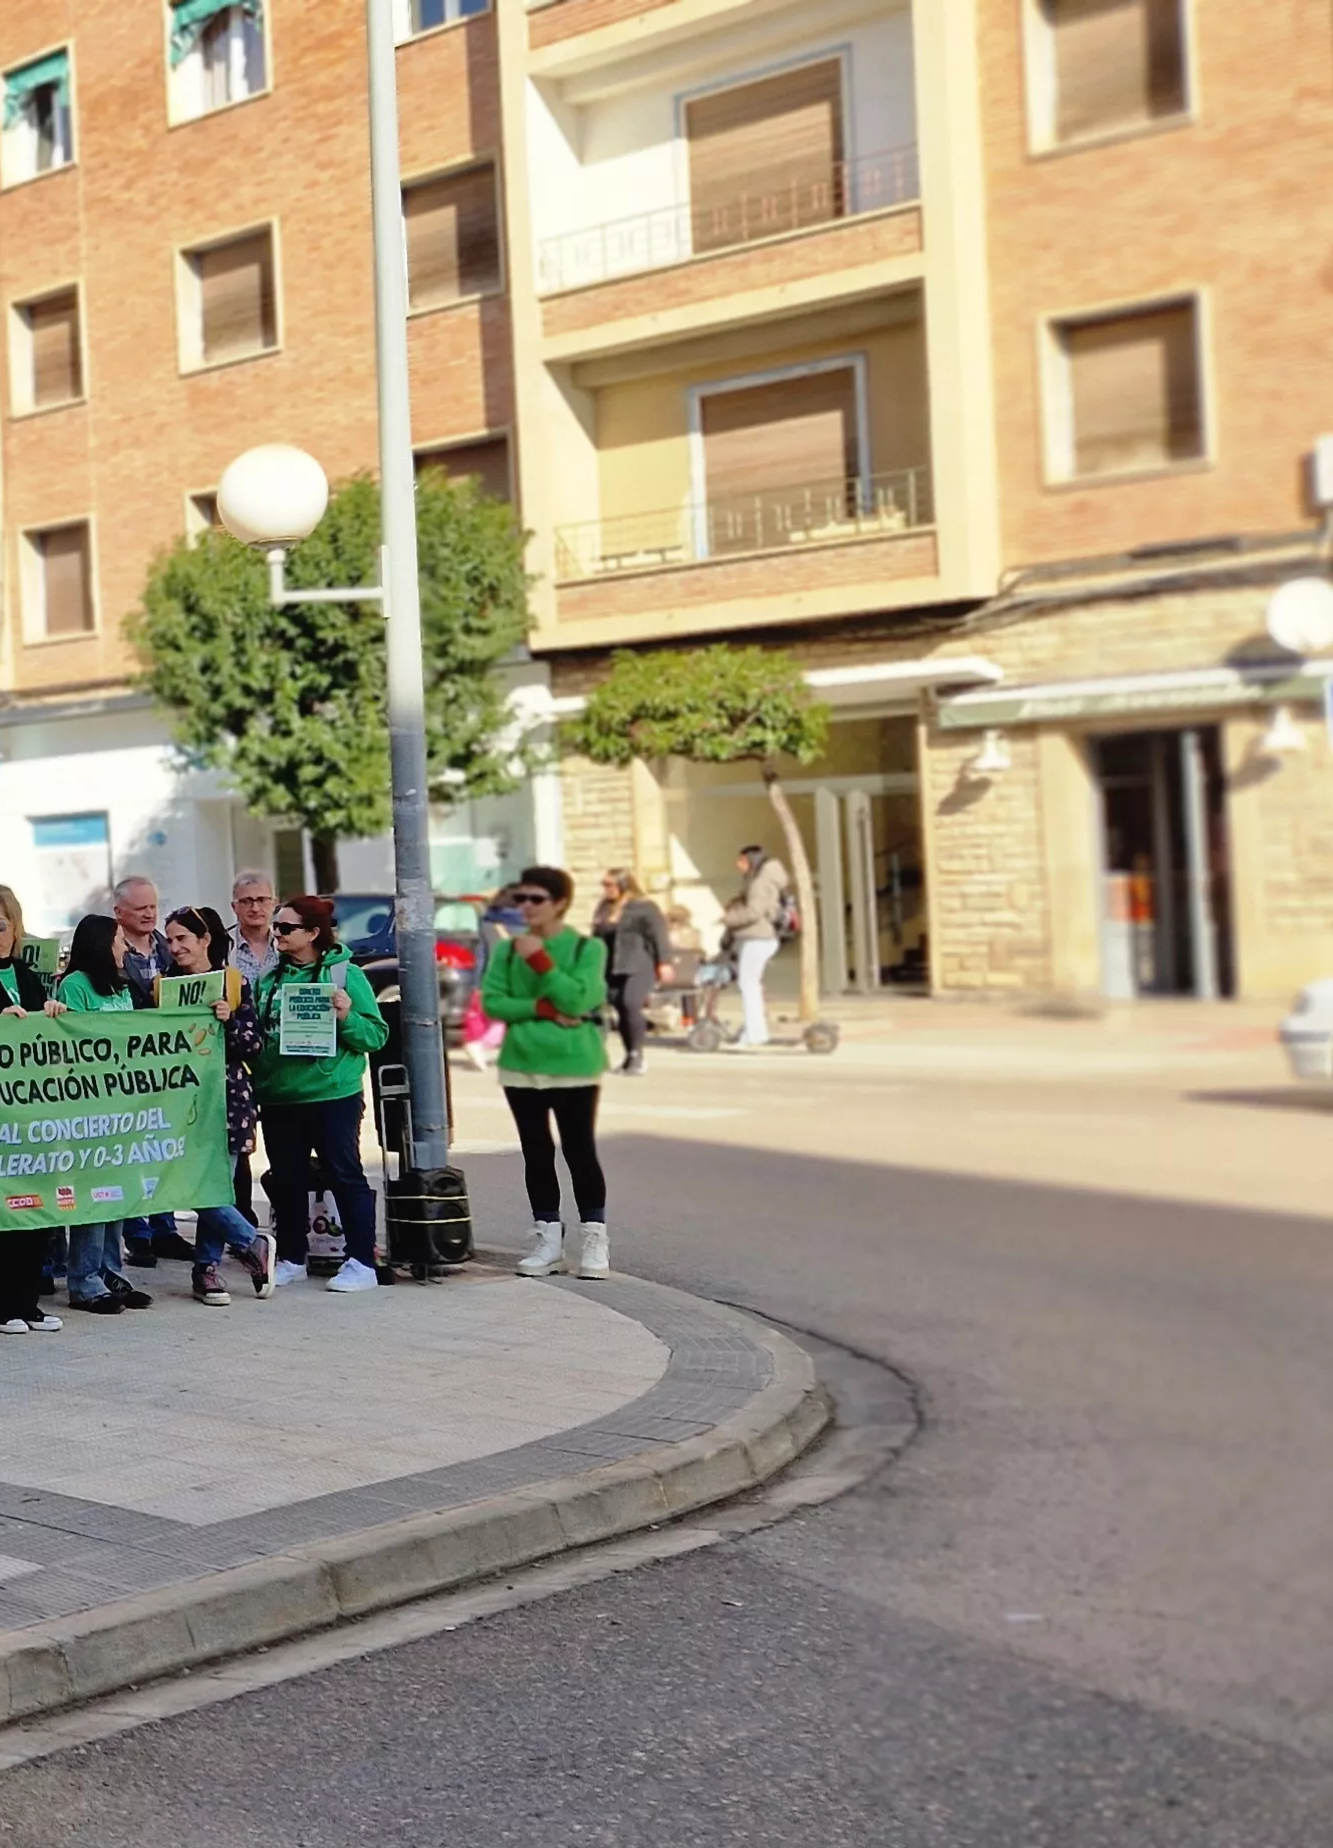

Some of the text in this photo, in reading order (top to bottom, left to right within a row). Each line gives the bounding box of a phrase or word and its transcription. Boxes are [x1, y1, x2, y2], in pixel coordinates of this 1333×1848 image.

[22, 944, 41, 969] O!
[177, 980, 207, 1007] NO!
[19, 1033, 120, 1067] PÚBLICO,
[126, 1029, 193, 1059] PARA
[103, 1062, 201, 1097] PÚBLICA
[27, 1111, 134, 1144] CONCIERTO
[134, 1106, 172, 1131] DEL
[79, 1147, 95, 1170] Y
[93, 1143, 124, 1169] 0-3
